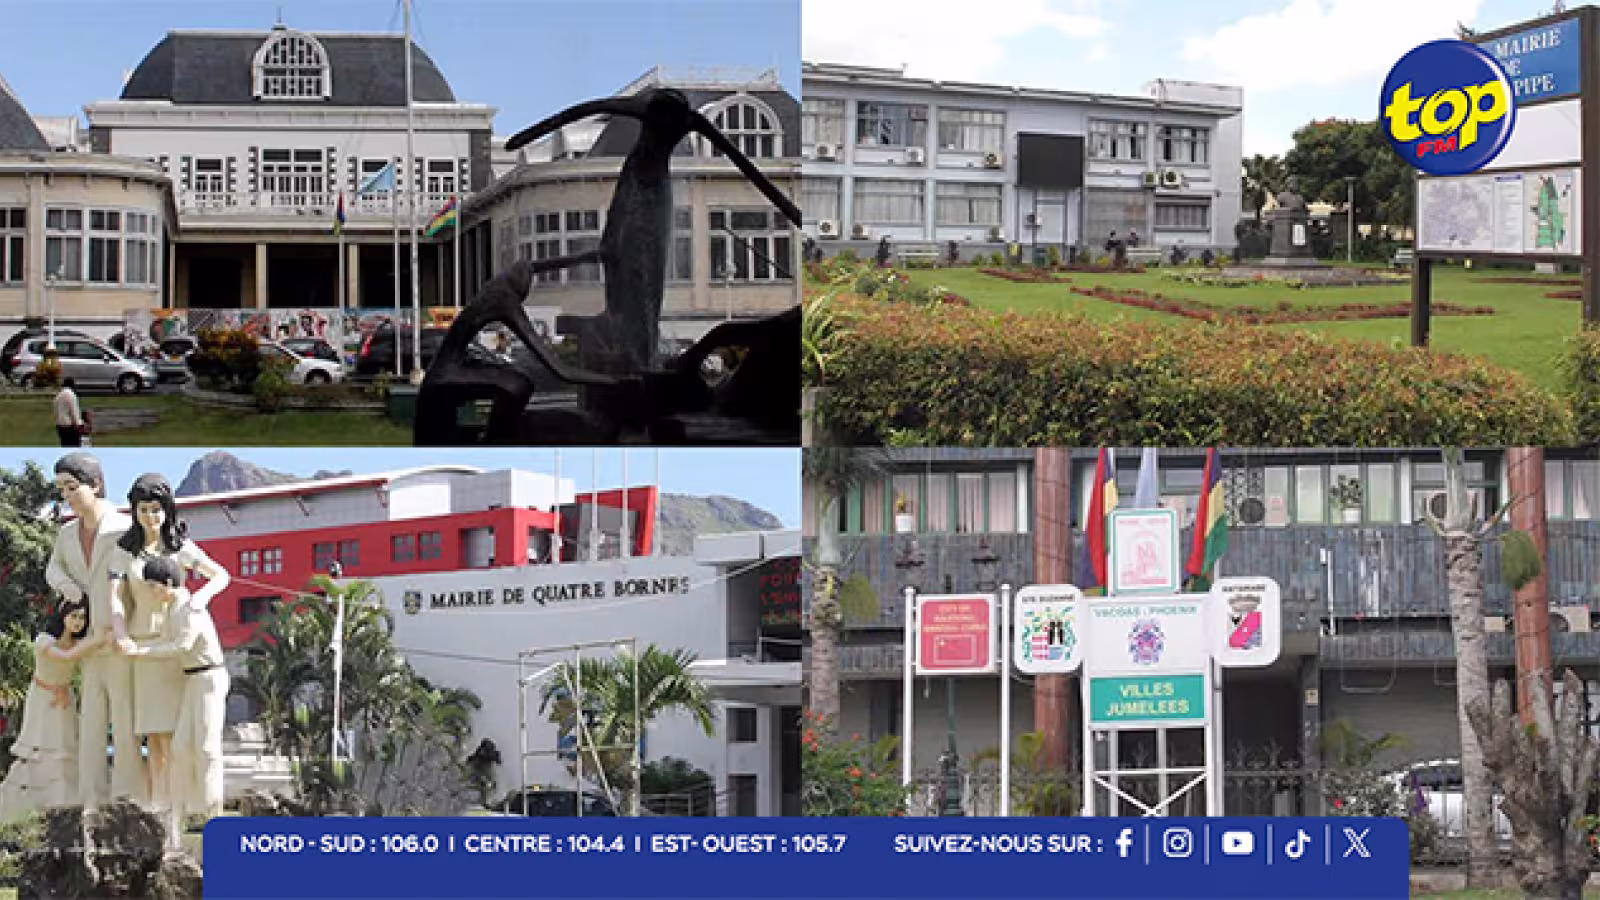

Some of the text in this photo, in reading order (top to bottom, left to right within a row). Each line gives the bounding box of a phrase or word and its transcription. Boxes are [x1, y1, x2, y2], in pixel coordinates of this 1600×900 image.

[1496, 27, 1561, 56] MAIRIE
[1514, 73, 1554, 96] PIPE
[430, 576, 689, 609] MAIRIE DE QUATRE BORNES
[1120, 682, 1175, 697] VILLES
[1106, 699, 1190, 716] JUMELEES
